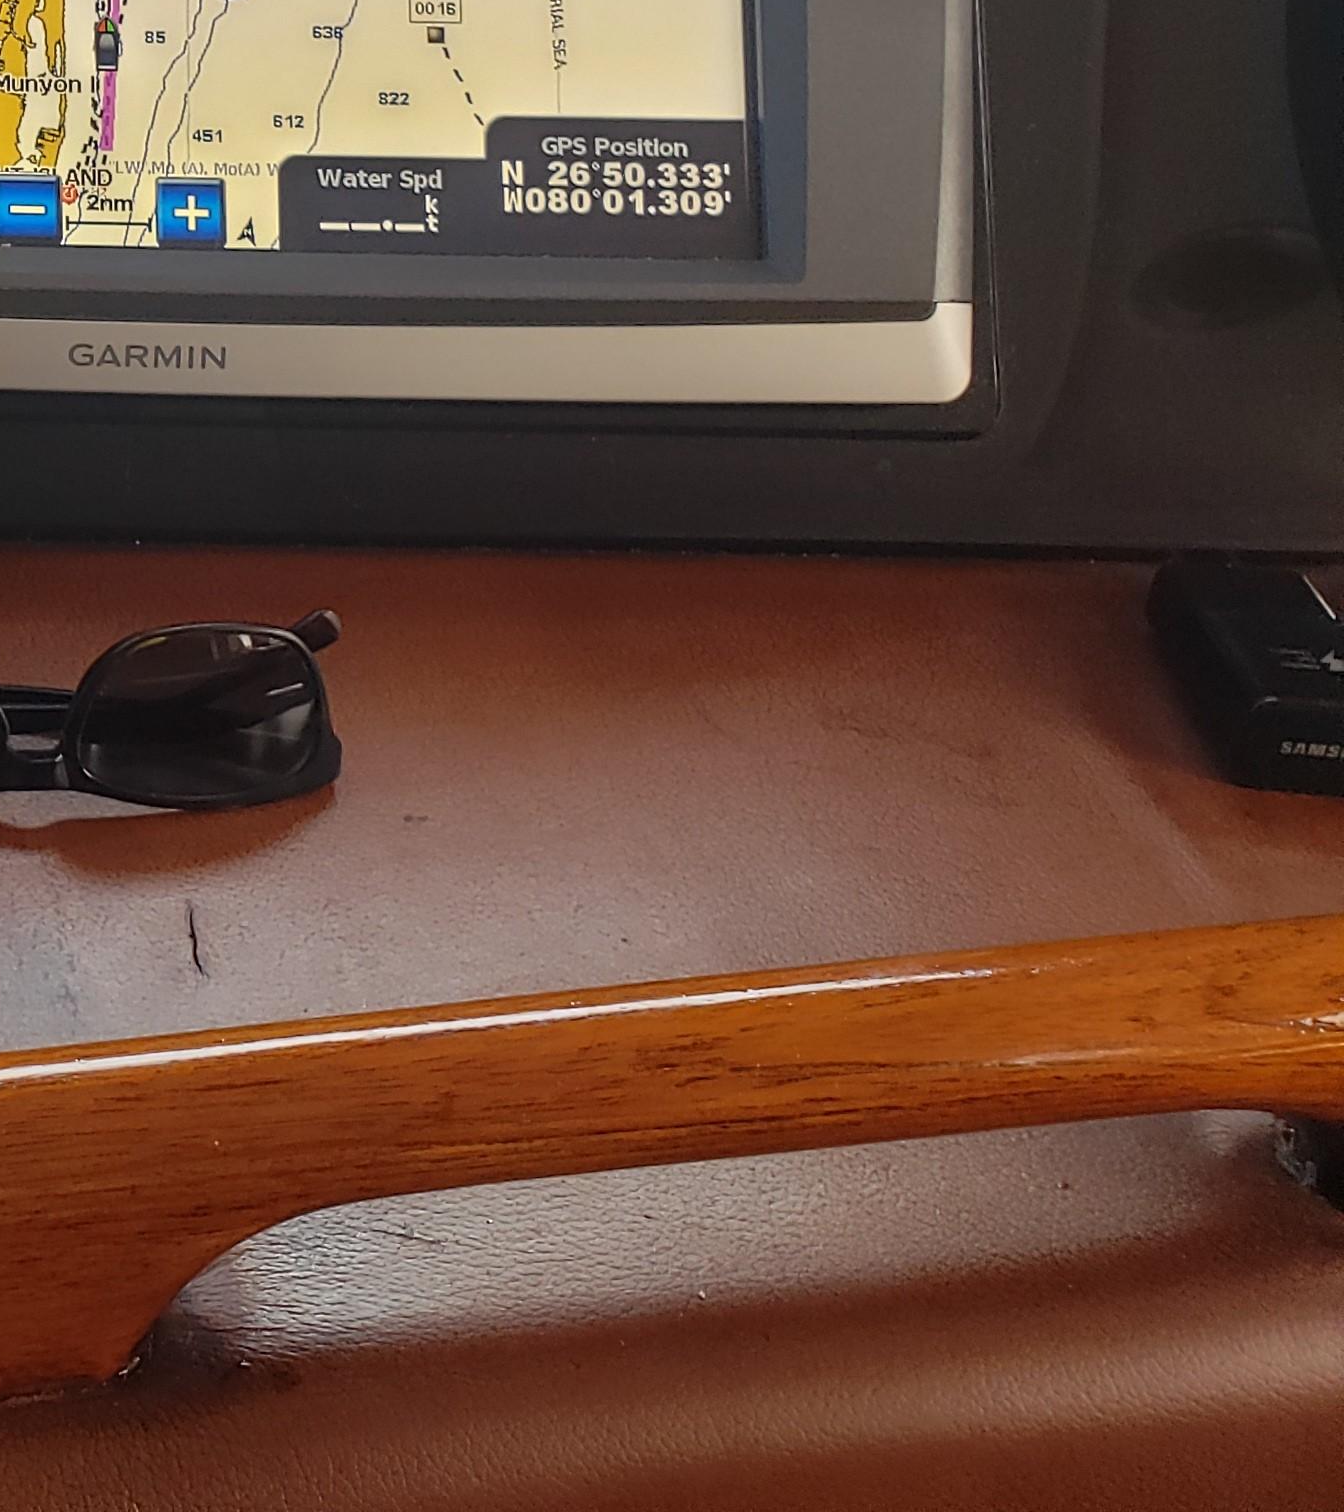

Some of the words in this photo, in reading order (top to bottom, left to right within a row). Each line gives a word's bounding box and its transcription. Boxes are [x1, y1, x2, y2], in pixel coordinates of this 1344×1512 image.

[415, 2, 456, 16] 0016
[145, 31, 166, 44] 85
[552, 38, 568, 70] SEA
[378, 92, 410, 106] 822
[272, 115, 305, 128] 612
[192, 130, 223, 143] 451
[541, 136, 588, 156] GPS
[593, 136, 689, 157] Position
[317, 168, 392, 188] Water
[399, 169, 443, 193] Spd
[501, 159, 524, 187] N
[86, 194, 133, 212] 2nm
[68, 343, 227, 370] GARMIN
[1280, 741, 1344, 759] SAMS
